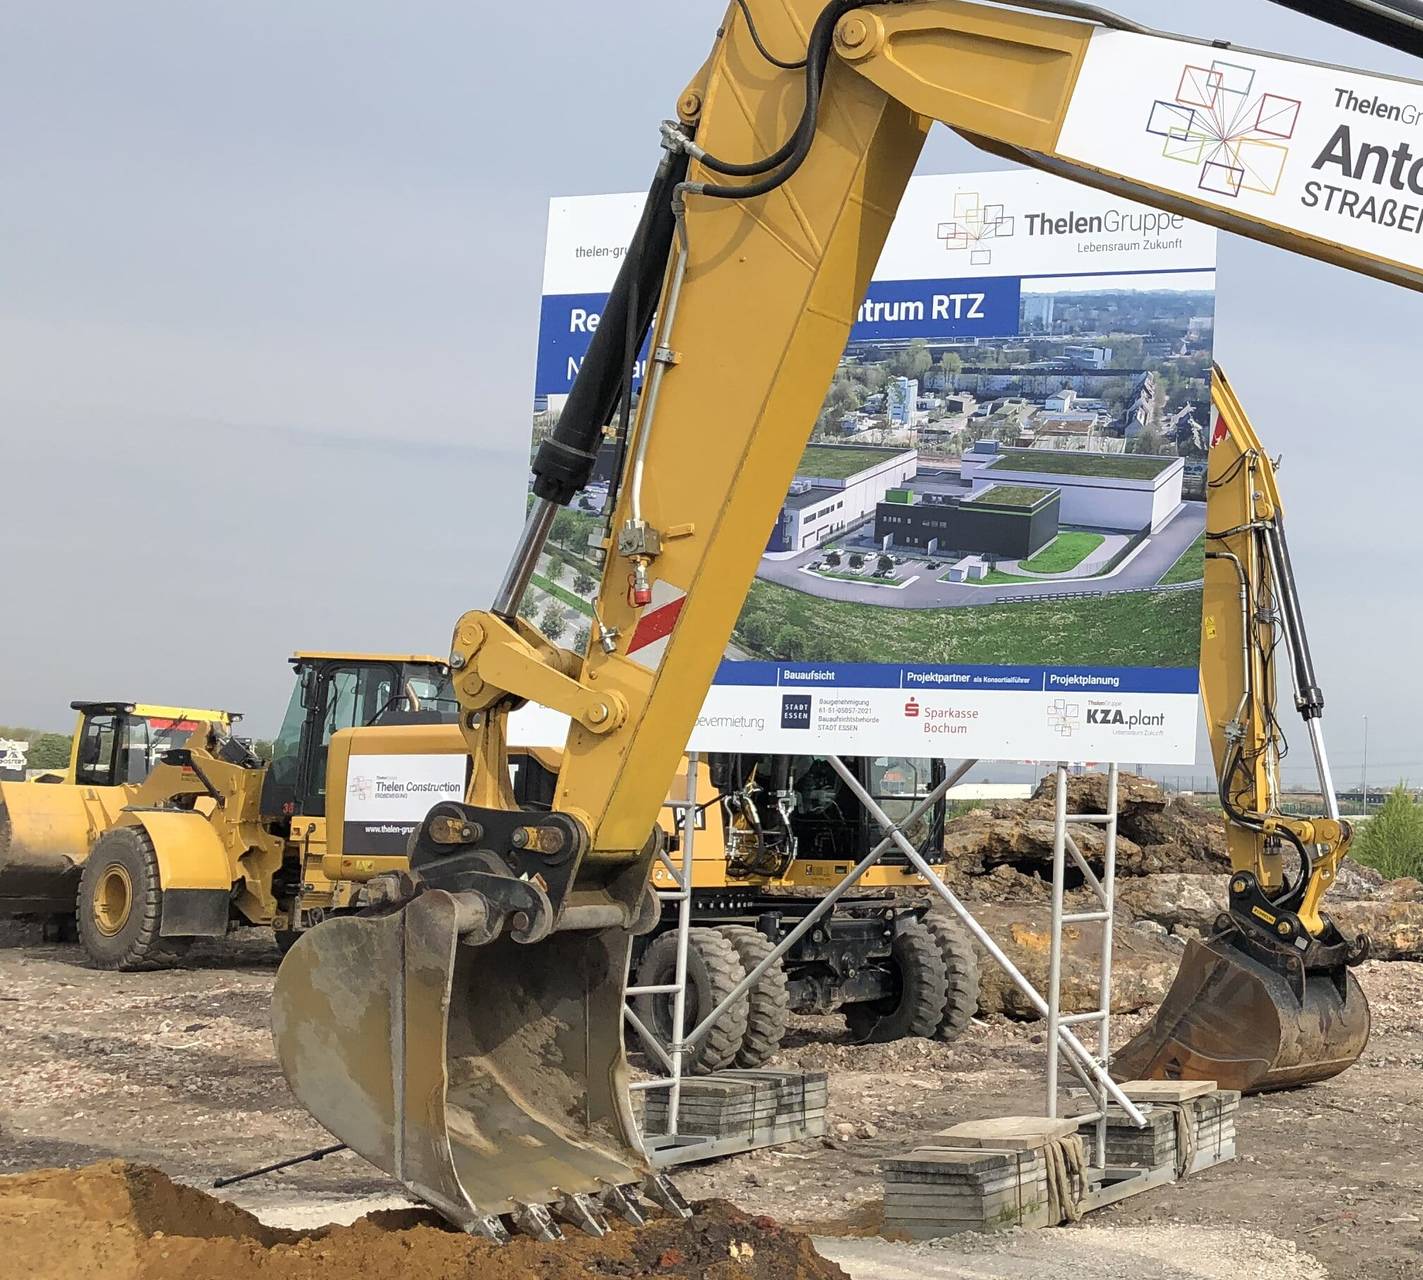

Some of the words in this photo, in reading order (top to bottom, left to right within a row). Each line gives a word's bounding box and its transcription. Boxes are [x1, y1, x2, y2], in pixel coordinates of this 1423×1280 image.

[1024, 209, 1185, 237] ThelenGruppe
[1077, 241, 1141, 253] Lebensraum
[1143, 238, 1183, 250] Zukunft
[932, 293, 985, 320] RTZ
[784, 669, 836, 681] Bauaufsicht
[907, 671, 971, 684] Projektpartner
[1050, 674, 1120, 687] Projektplanung
[784, 703, 808, 711] STADT
[924, 707, 979, 720] Sparkasse
[1086, 708, 1165, 730] KZA.plant
[923, 722, 967, 734] Bochum
[375, 781, 405, 792] Thelen
[406, 781, 461, 792] Construction
